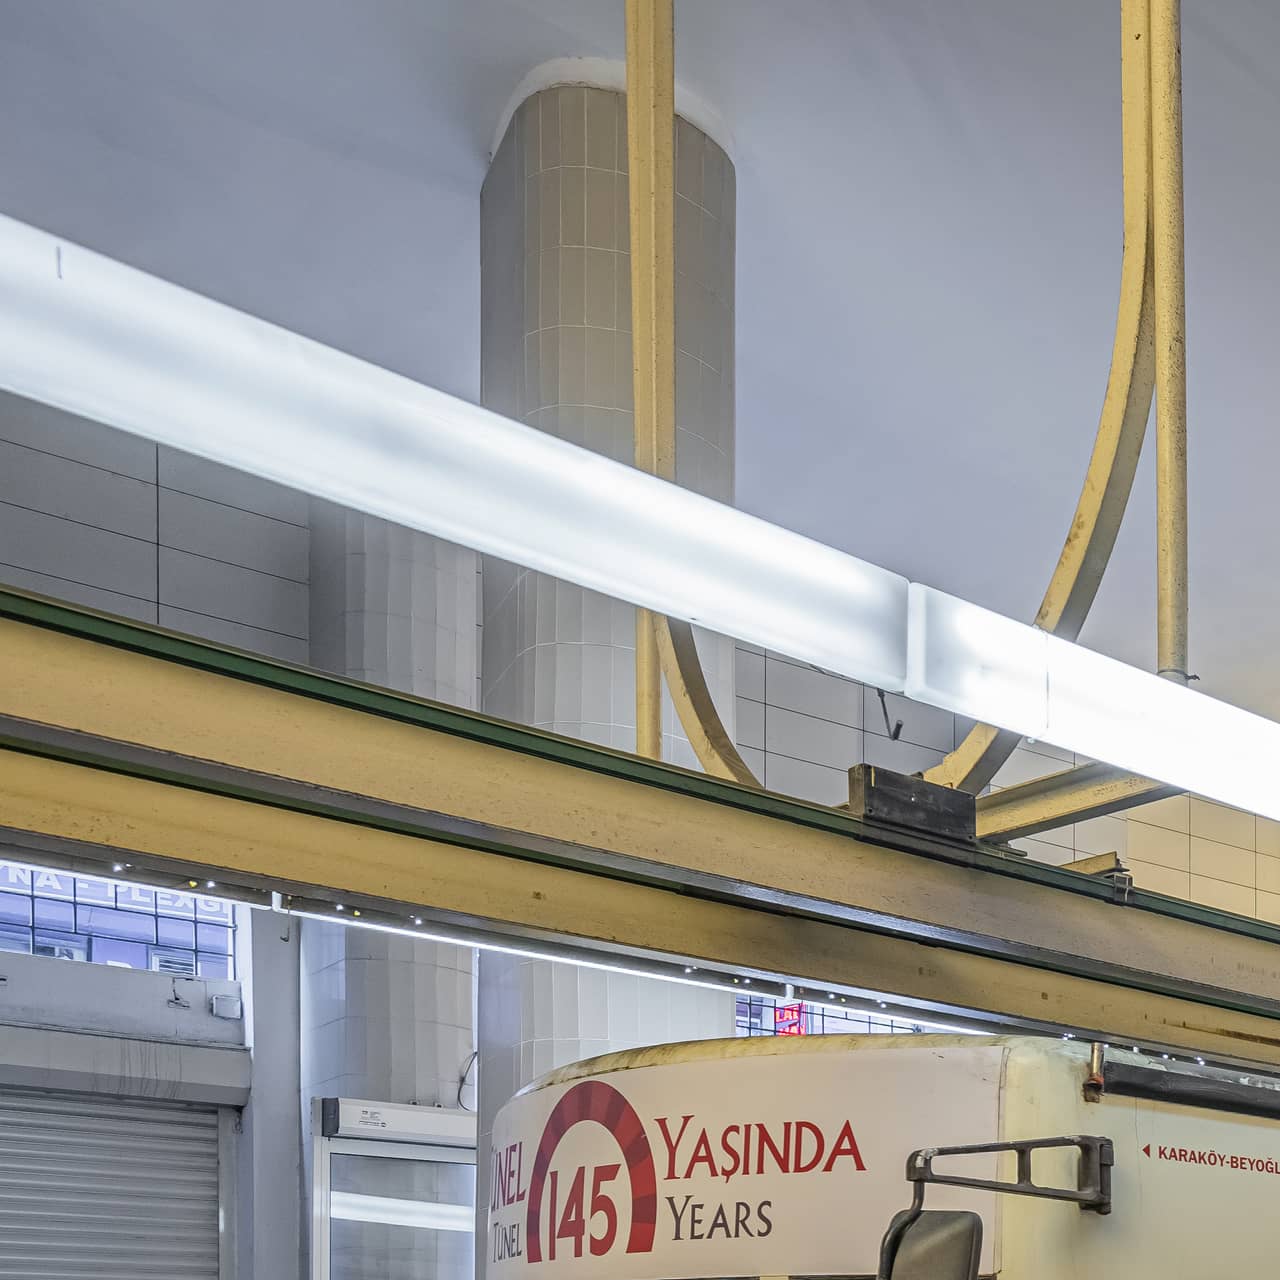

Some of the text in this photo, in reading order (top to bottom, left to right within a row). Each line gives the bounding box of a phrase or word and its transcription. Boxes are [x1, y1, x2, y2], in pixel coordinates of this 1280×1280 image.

[654, 1115, 867, 1183] YAŞINDA
[549, 1163, 622, 1261] 145
[664, 1194, 773, 1241] YEARS
